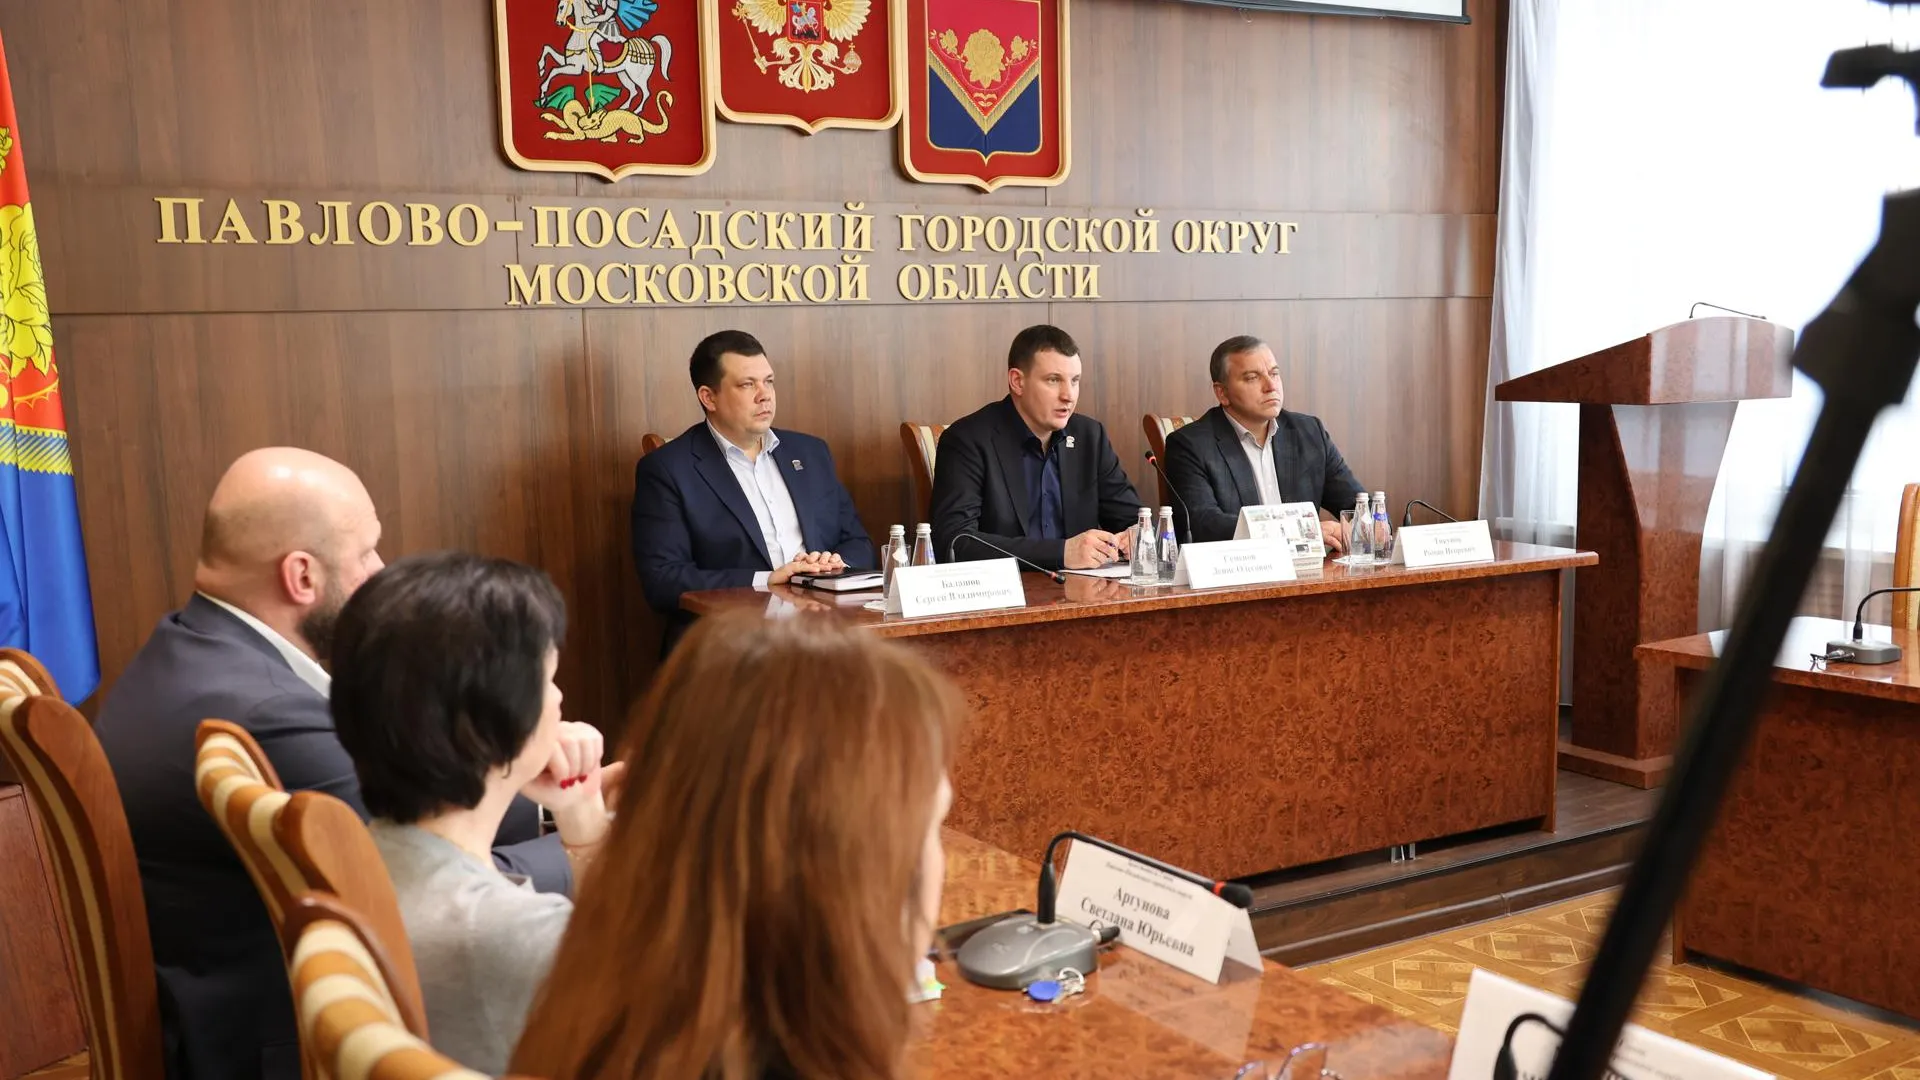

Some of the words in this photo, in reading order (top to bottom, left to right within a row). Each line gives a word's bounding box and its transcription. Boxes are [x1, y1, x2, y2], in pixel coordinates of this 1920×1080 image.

[153, 197, 875, 259] ПАВЛОВО-ПОСАДСКИЙ
[897, 208, 1161, 261] ГОРОДСКОЙ
[1173, 218, 1299, 254] ОКРУГ
[505, 254, 872, 306] МОСКОВСКОЙ
[897, 262, 1101, 301] ОБЛАСТИ
[1081, 896, 1135, 931] Светлана
[1137, 919, 1195, 957] Юрьевна
[1112, 886, 1170, 920] Аргунова
